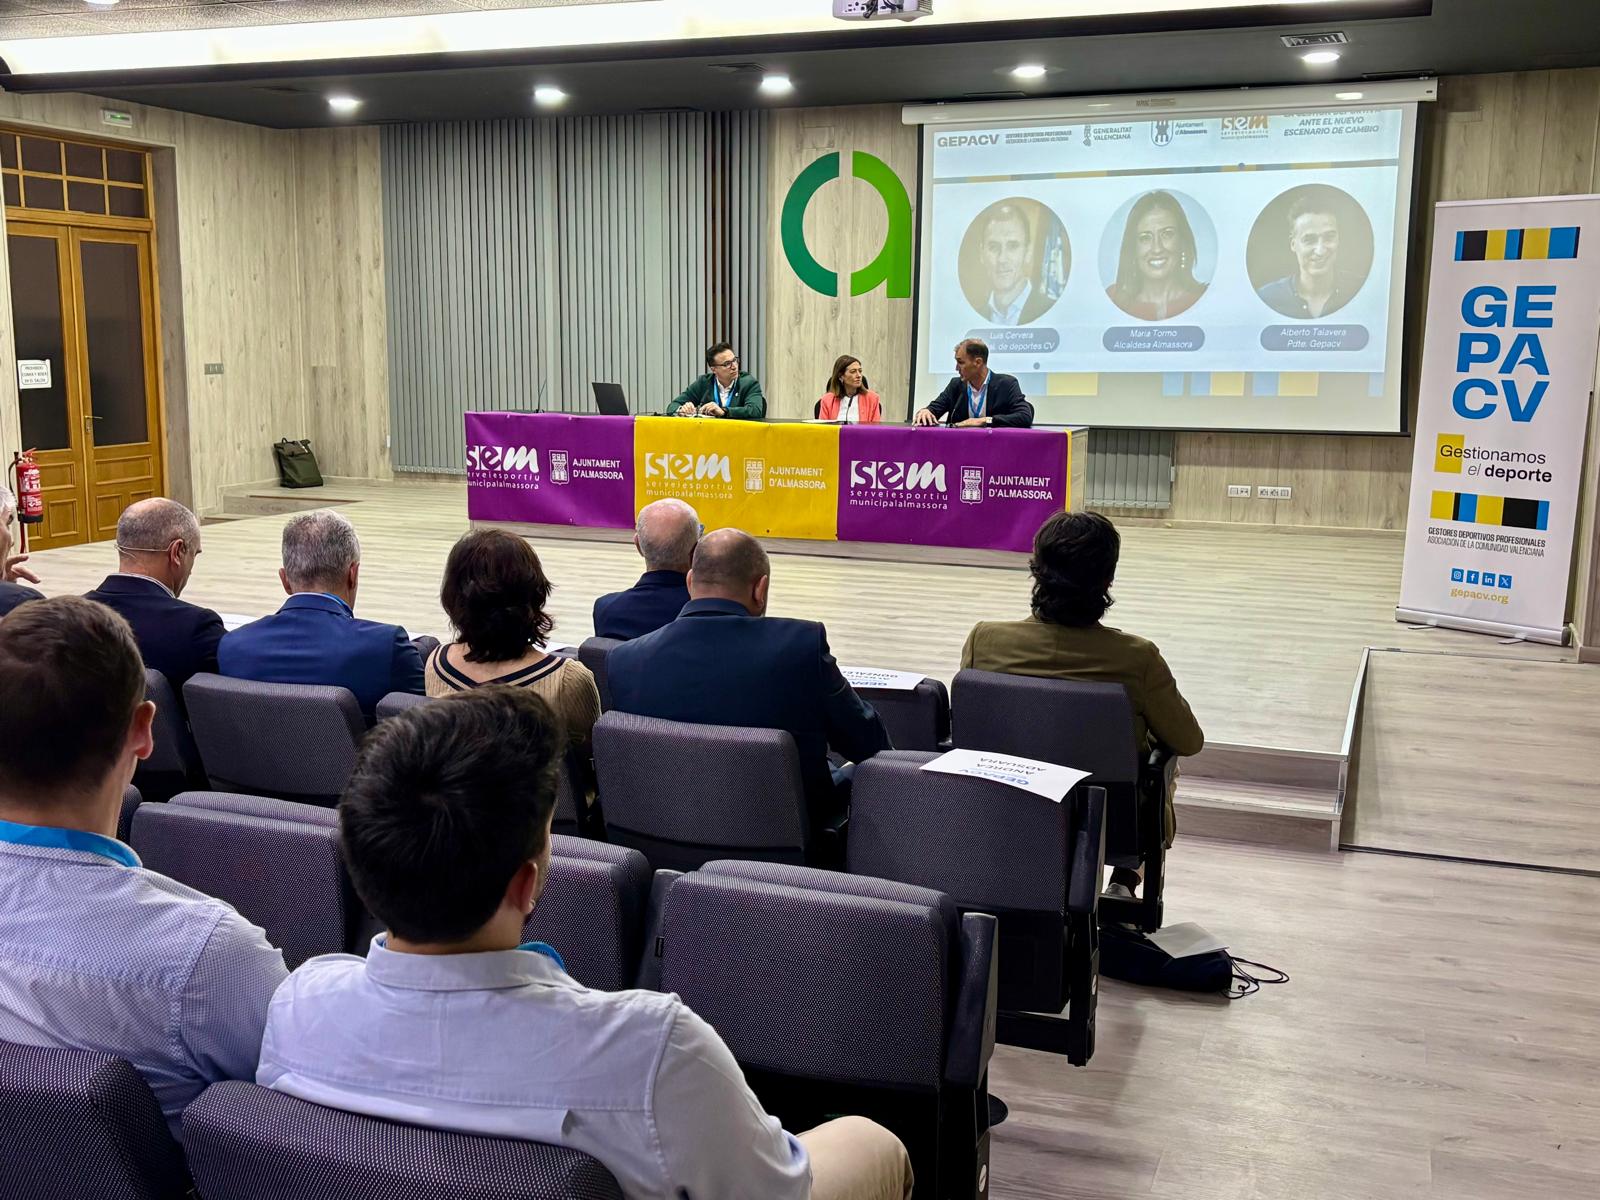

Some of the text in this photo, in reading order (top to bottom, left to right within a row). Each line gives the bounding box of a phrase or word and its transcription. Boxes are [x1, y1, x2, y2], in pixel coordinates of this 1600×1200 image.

[1299, 116, 1364, 126] ANTE EL NUEVO
[1093, 127, 1132, 135] GENERALITAT
[1093, 133, 1132, 141] VALENCIANA
[1283, 125, 1380, 137] ESCENARIO DE CAMBIO
[937, 134, 1000, 148] GEPACV
[1461, 285, 1557, 328] GE
[1005, 331, 1034, 339] Cervera
[1152, 329, 1178, 337] Tormo
[1280, 327, 1347, 336] Alberto Talavera
[998, 343, 1009, 351] de
[1009, 342, 1041, 352] deportes
[1043, 342, 1055, 350] CV
[1114, 341, 1193, 349] Alcaldesa Almassora
[1309, 339, 1342, 349] Gepacv
[1456, 332, 1550, 376] PA
[1452, 378, 1550, 423] CV
[1440, 444, 1546, 465] Gestionamos
[572, 458, 621, 469] AJUNTAMENT
[645, 452, 731, 483] sem
[572, 469, 624, 481] D'ALMASSORA
[769, 466, 823, 477] AJUNTAMENT
[850, 460, 947, 493] sem
[1467, 463, 1553, 483] el deporte
[645, 480, 733, 492] serveiesportiu
[769, 479, 826, 490] D'ALMASSORA
[988, 475, 1051, 488] AJUNTAMENT
[645, 488, 733, 500] municipalalmassora
[850, 489, 948, 501] serveiesportiu
[988, 488, 1053, 501] D'ALMASSORA
[850, 498, 948, 510] municipalalmassora
[1428, 526, 1546, 548] GESTORES DEPORTIVOS PROFESIONALES
[1459, 539, 1467, 548] DE
[1467, 540, 1475, 549] LA
[1475, 541, 1509, 553] COMUNIDAD
[1509, 545, 1545, 558] VALENCIANA
[1450, 587, 1509, 605] gepacv.org
